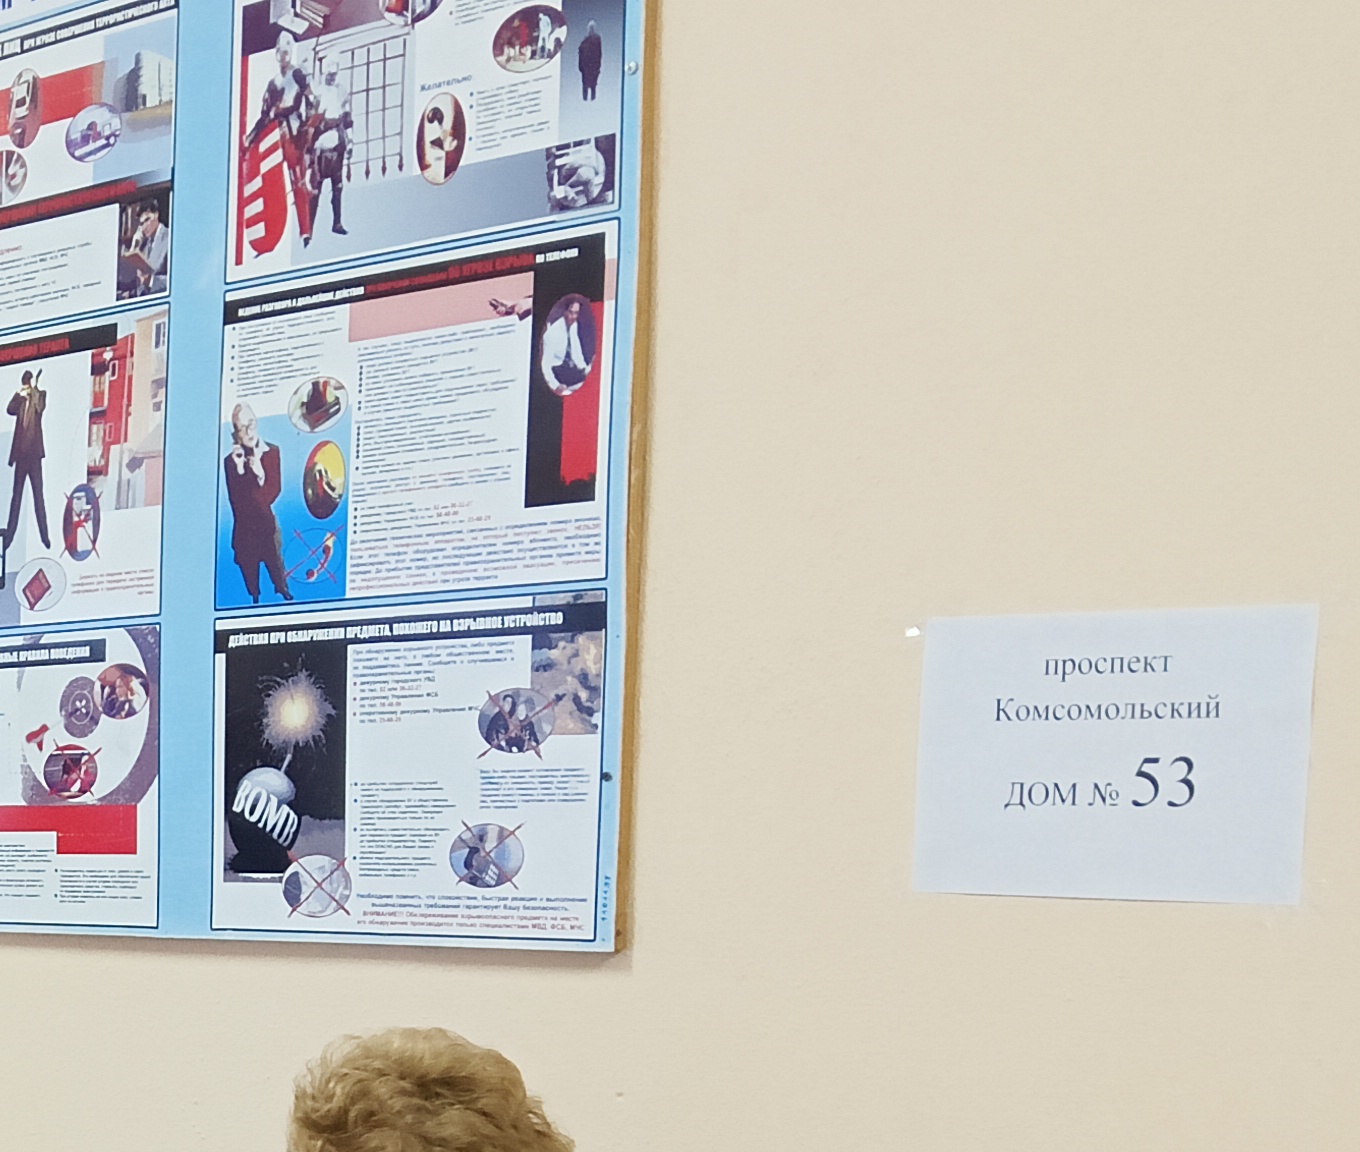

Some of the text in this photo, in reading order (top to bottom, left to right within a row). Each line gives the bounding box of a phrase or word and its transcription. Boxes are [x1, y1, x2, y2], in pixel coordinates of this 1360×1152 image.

[1044, 654, 1173, 682] проспект
[994, 694, 1221, 722] Комсомольский
[1004, 756, 1196, 811] ДОМ № 53
[232, 780, 299, 847] BOMB
